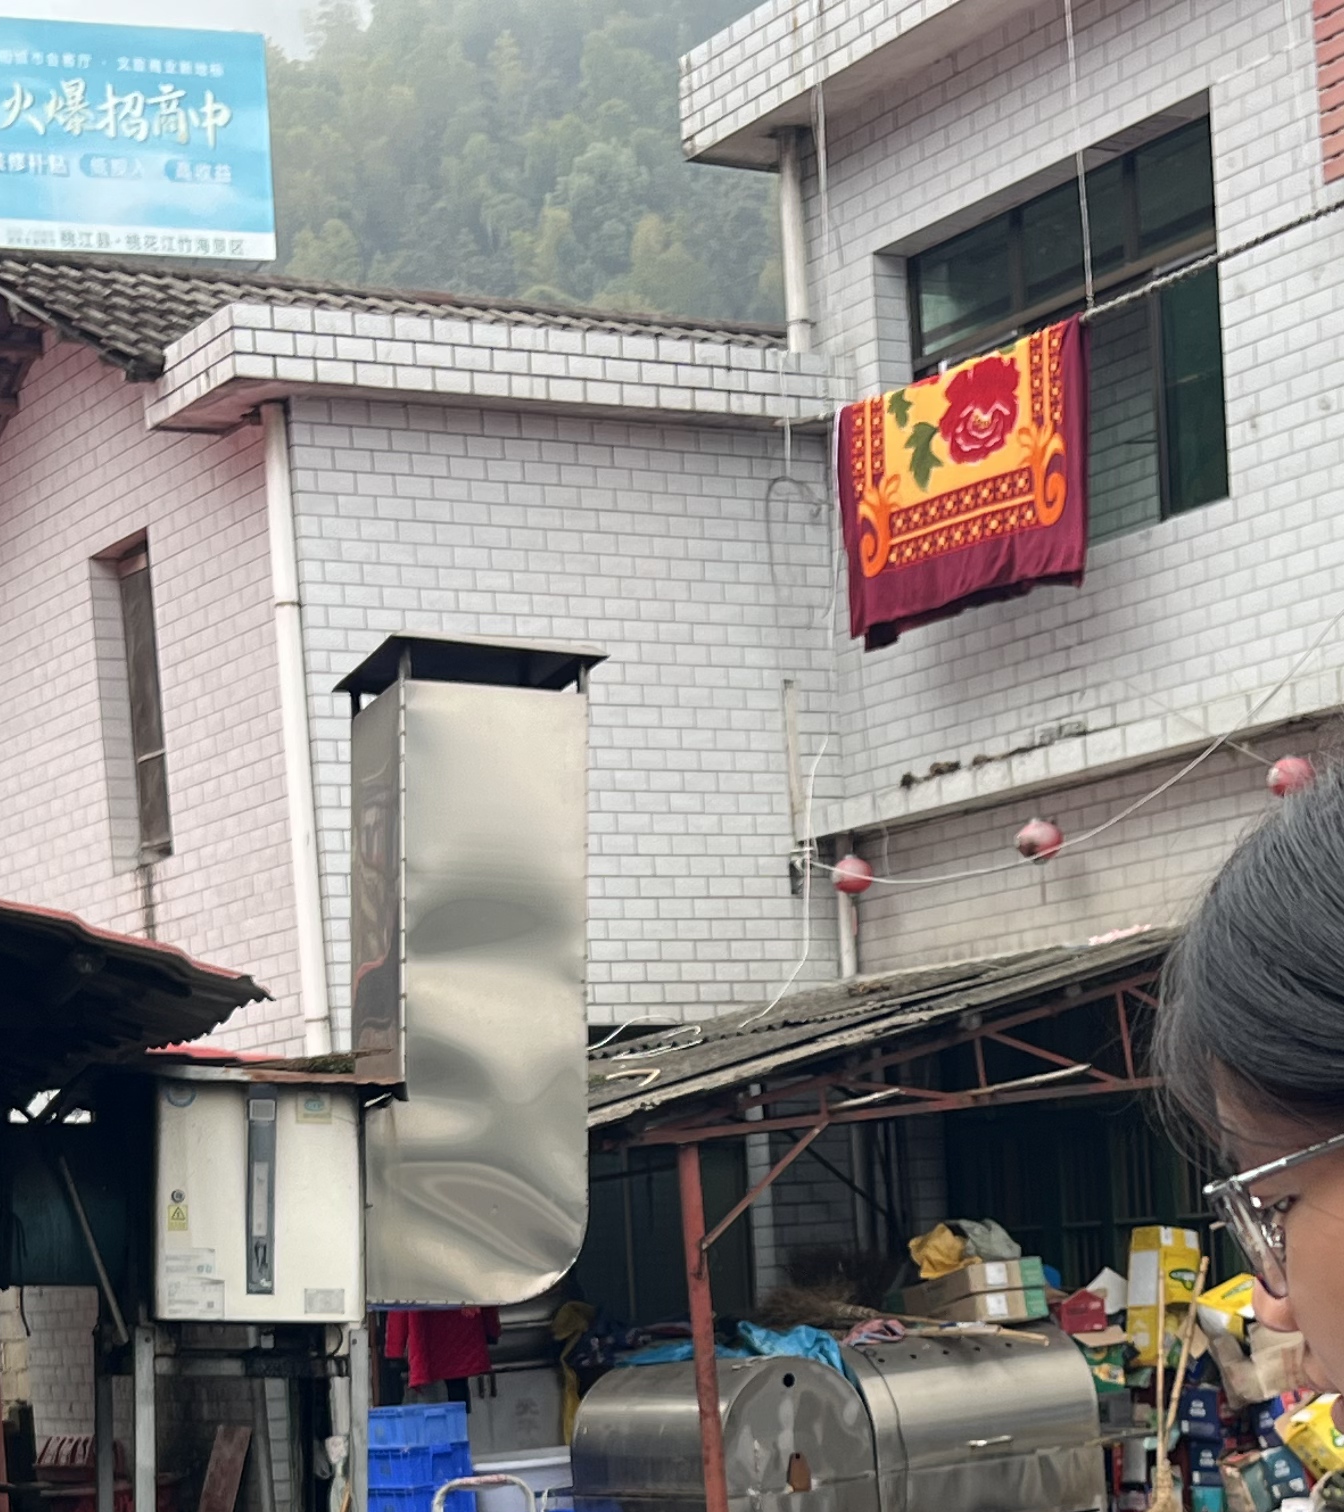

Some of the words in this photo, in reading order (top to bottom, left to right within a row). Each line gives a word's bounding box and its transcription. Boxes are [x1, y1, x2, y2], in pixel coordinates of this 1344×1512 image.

[0, 79, 233, 148] 火爆招商中
